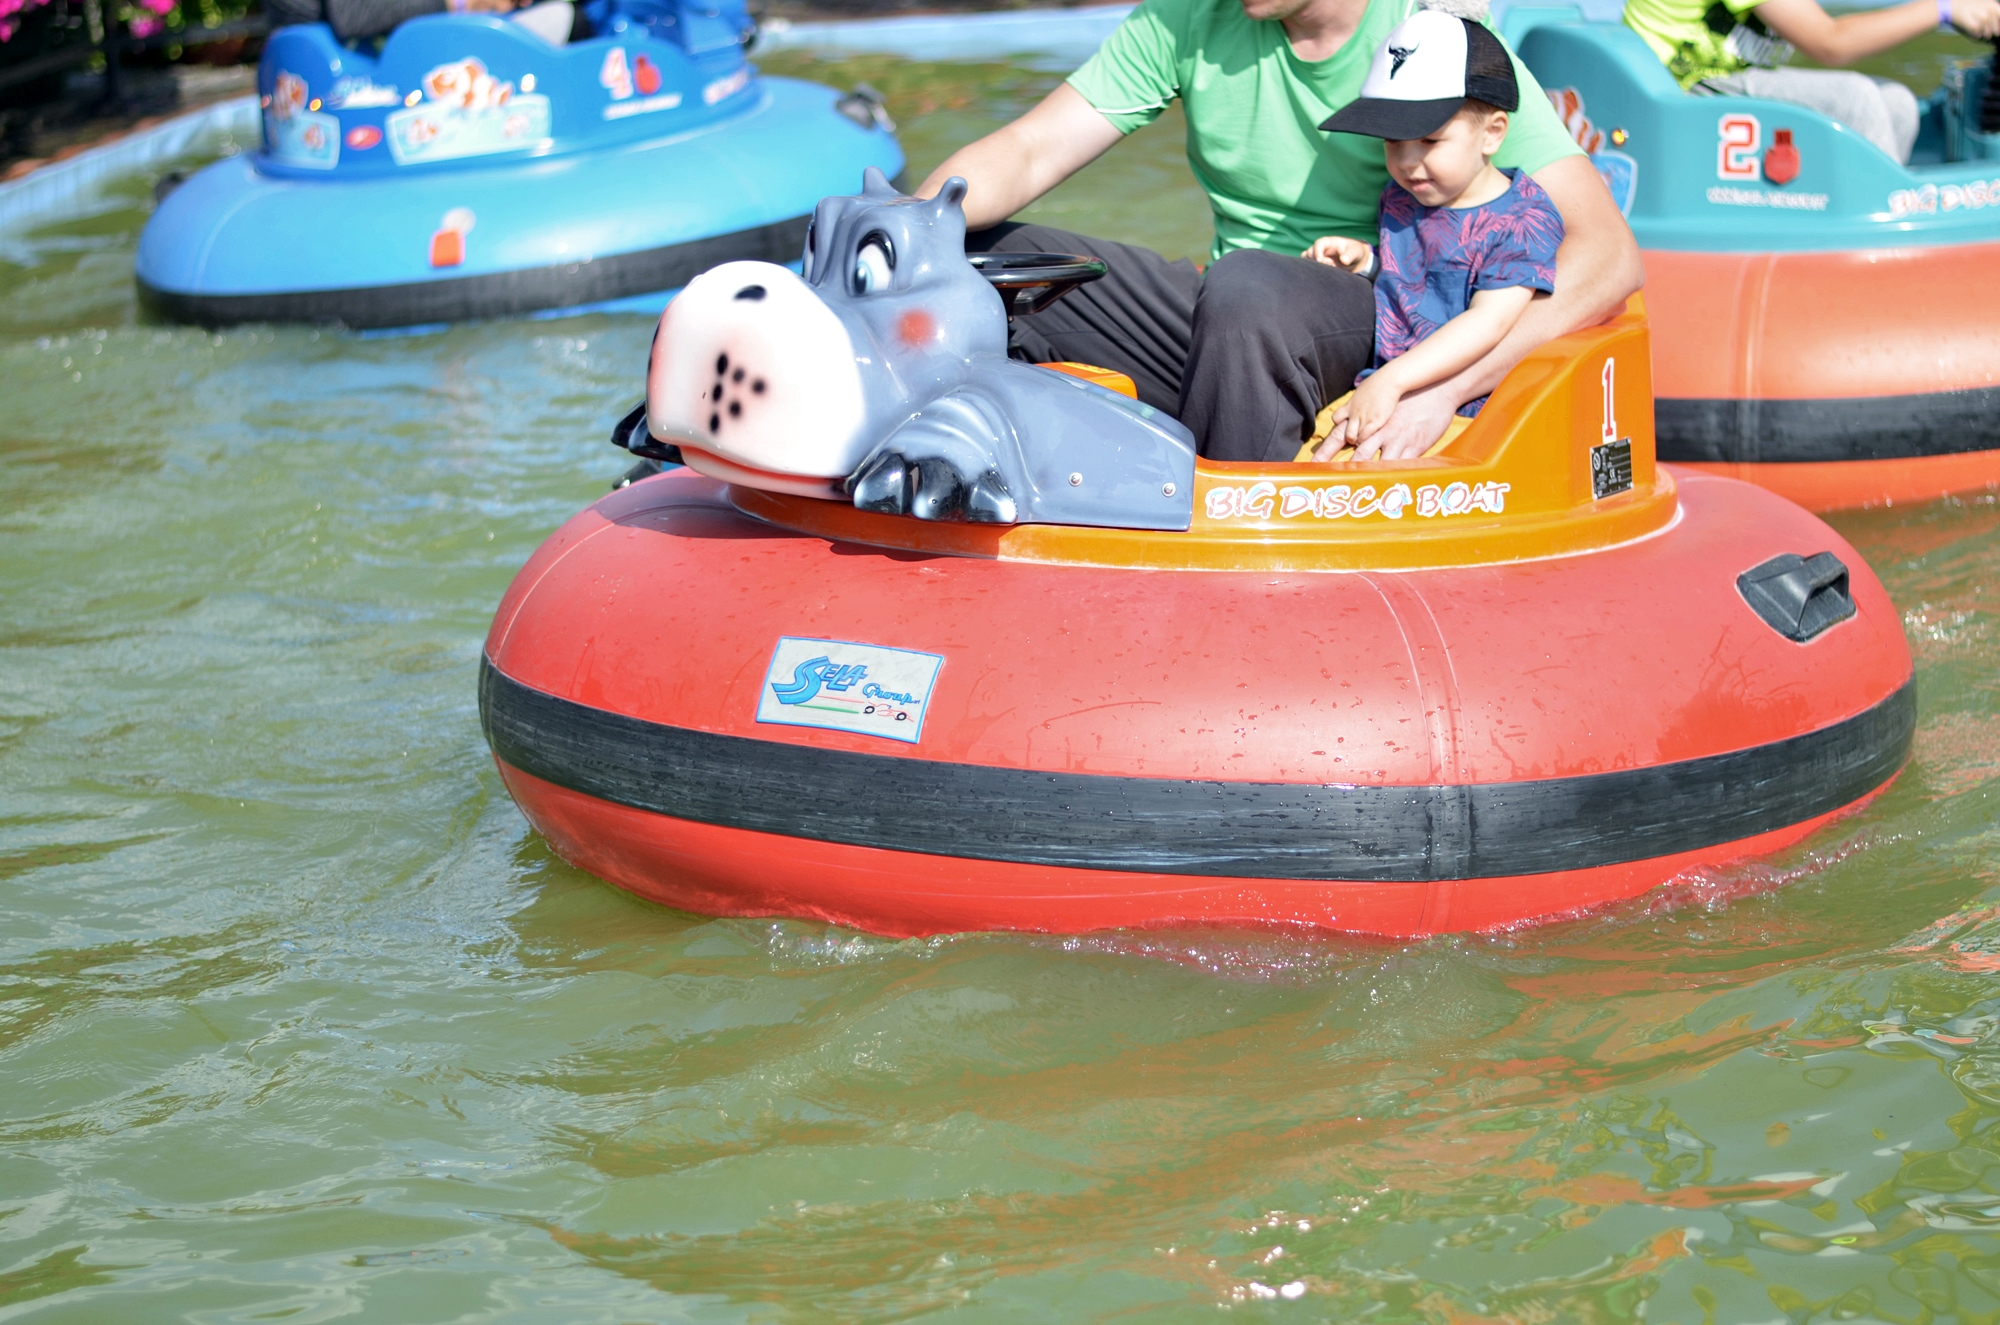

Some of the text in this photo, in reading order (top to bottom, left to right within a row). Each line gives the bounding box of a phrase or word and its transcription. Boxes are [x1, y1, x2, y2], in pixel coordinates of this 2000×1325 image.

[599, 46, 634, 100] 4
[1717, 113, 1761, 181] 2
[1888, 182, 1938, 219] BIG
[1602, 357, 1617, 444] 1
[1205, 481, 1511, 519] BIG DISCO BOAT
[771, 655, 869, 706] SELA
[862, 682, 914, 706] Group
